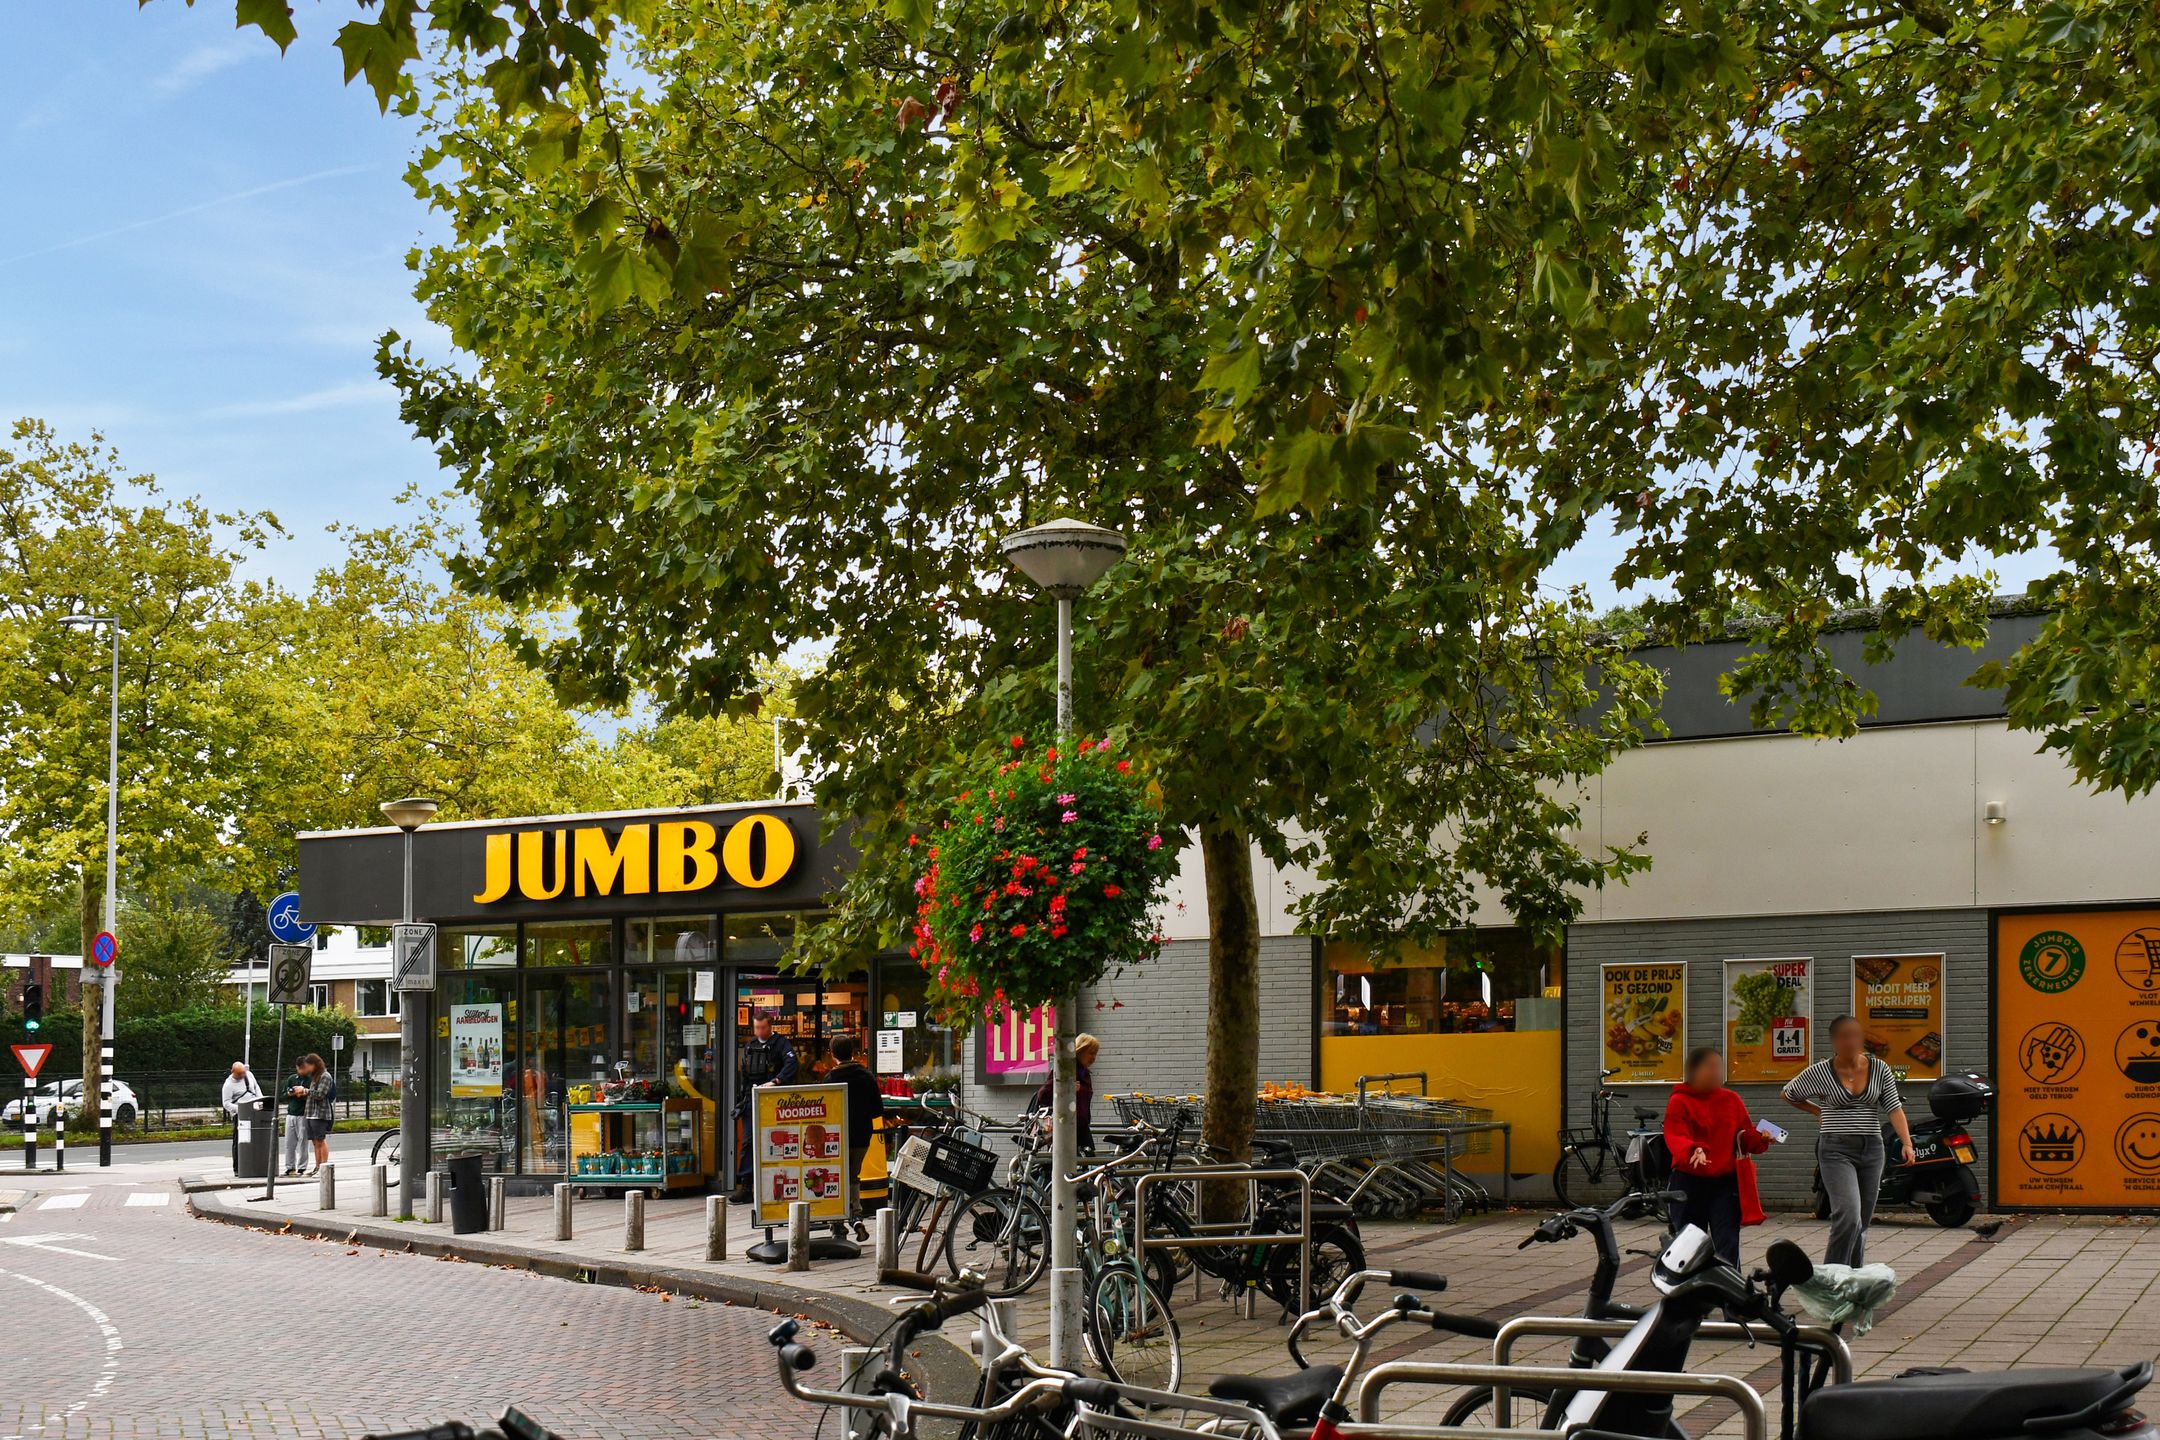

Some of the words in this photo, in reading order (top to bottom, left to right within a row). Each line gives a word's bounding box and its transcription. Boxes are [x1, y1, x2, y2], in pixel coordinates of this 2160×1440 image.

[473, 814, 796, 904] JUMBO
[403, 928, 423, 936] ZONE
[2033, 935, 2080, 954] JUMBO'S
[282, 948, 301, 956] ZONE
[2045, 951, 2062, 973] 7
[1605, 970, 1631, 982] OOK
[1634, 970, 1648, 981] DE
[1651, 969, 1682, 980] PRIJS
[1772, 961, 1806, 977] SUPER
[1613, 983, 1624, 995] IS
[1626, 982, 1673, 994] GEZOND
[1776, 977, 1802, 988] DEAL
[1867, 983, 1901, 994] NOOIT
[1903, 982, 1930, 993] MEER
[1865, 995, 1932, 1007] MISGRIJPEN?
[1776, 1029, 1800, 1046] 1+1
[1776, 1046, 1801, 1054] GRATIS
[777, 1096, 825, 1108] Weekend
[778, 1106, 825, 1119] VOORDEEL
